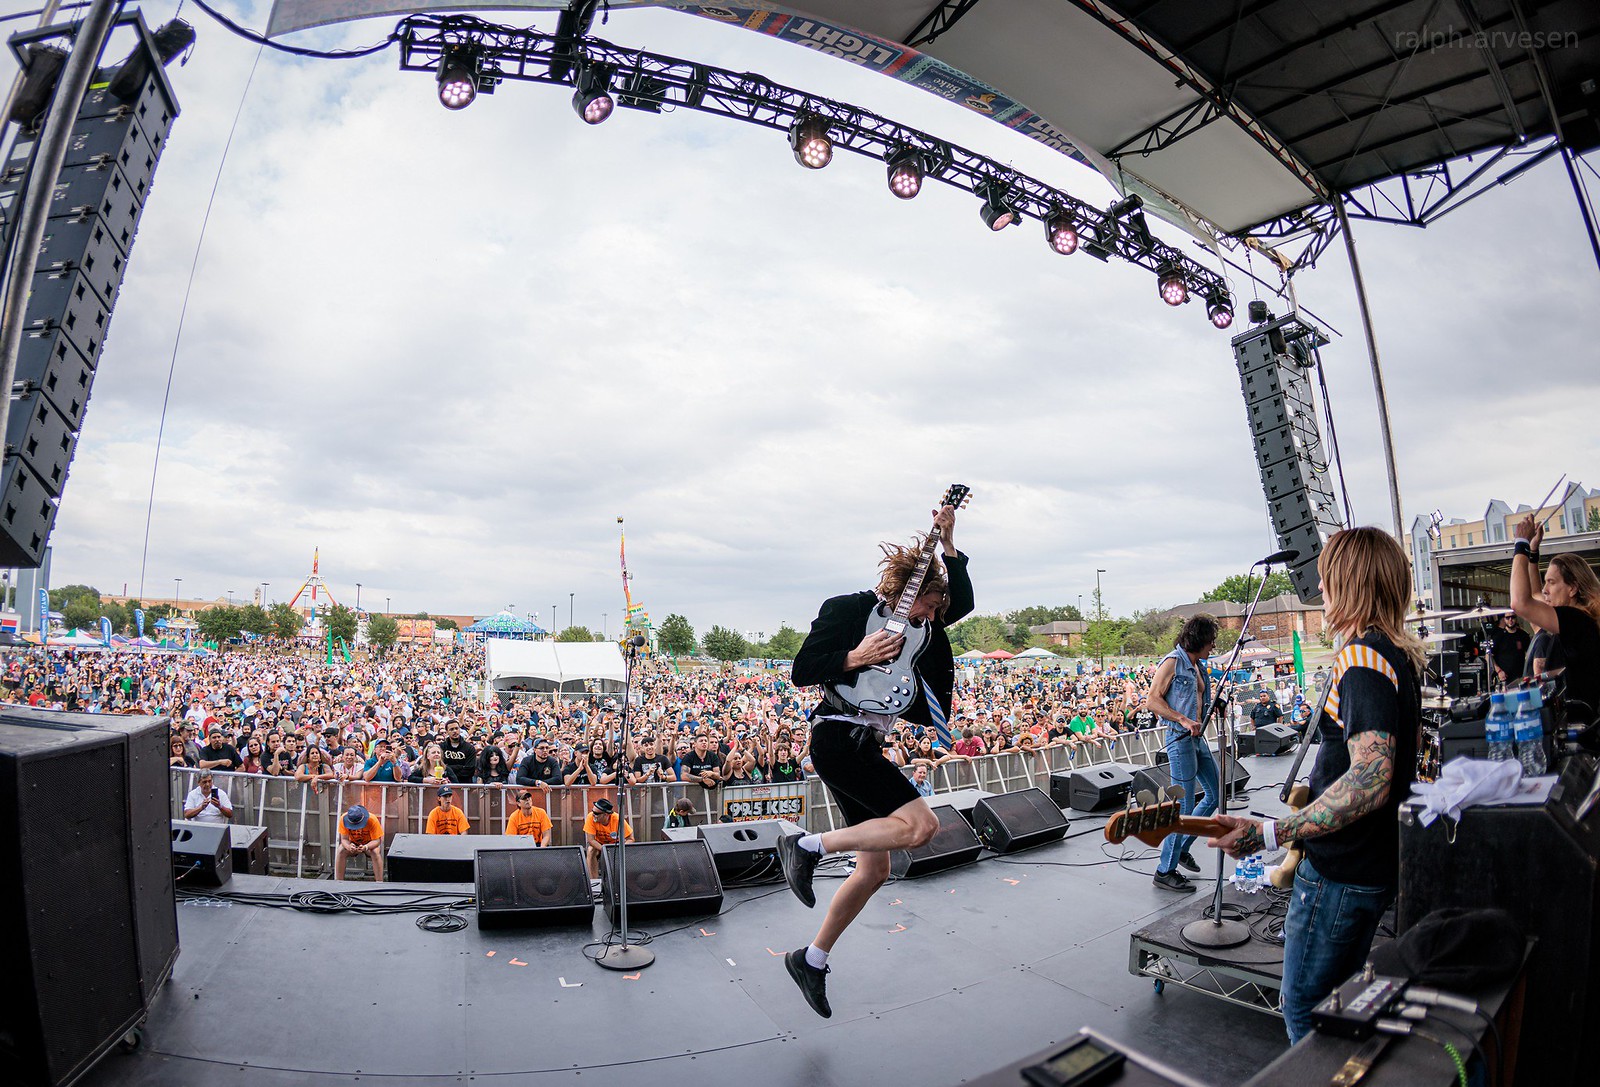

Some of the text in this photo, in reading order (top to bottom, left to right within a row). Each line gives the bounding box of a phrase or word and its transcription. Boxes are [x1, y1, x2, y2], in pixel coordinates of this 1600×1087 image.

[789, 21, 893, 64] LIGHT
[918, 82, 956, 99] Oyster
[933, 77, 962, 94] Bake
[766, 799, 801, 816] KISS
